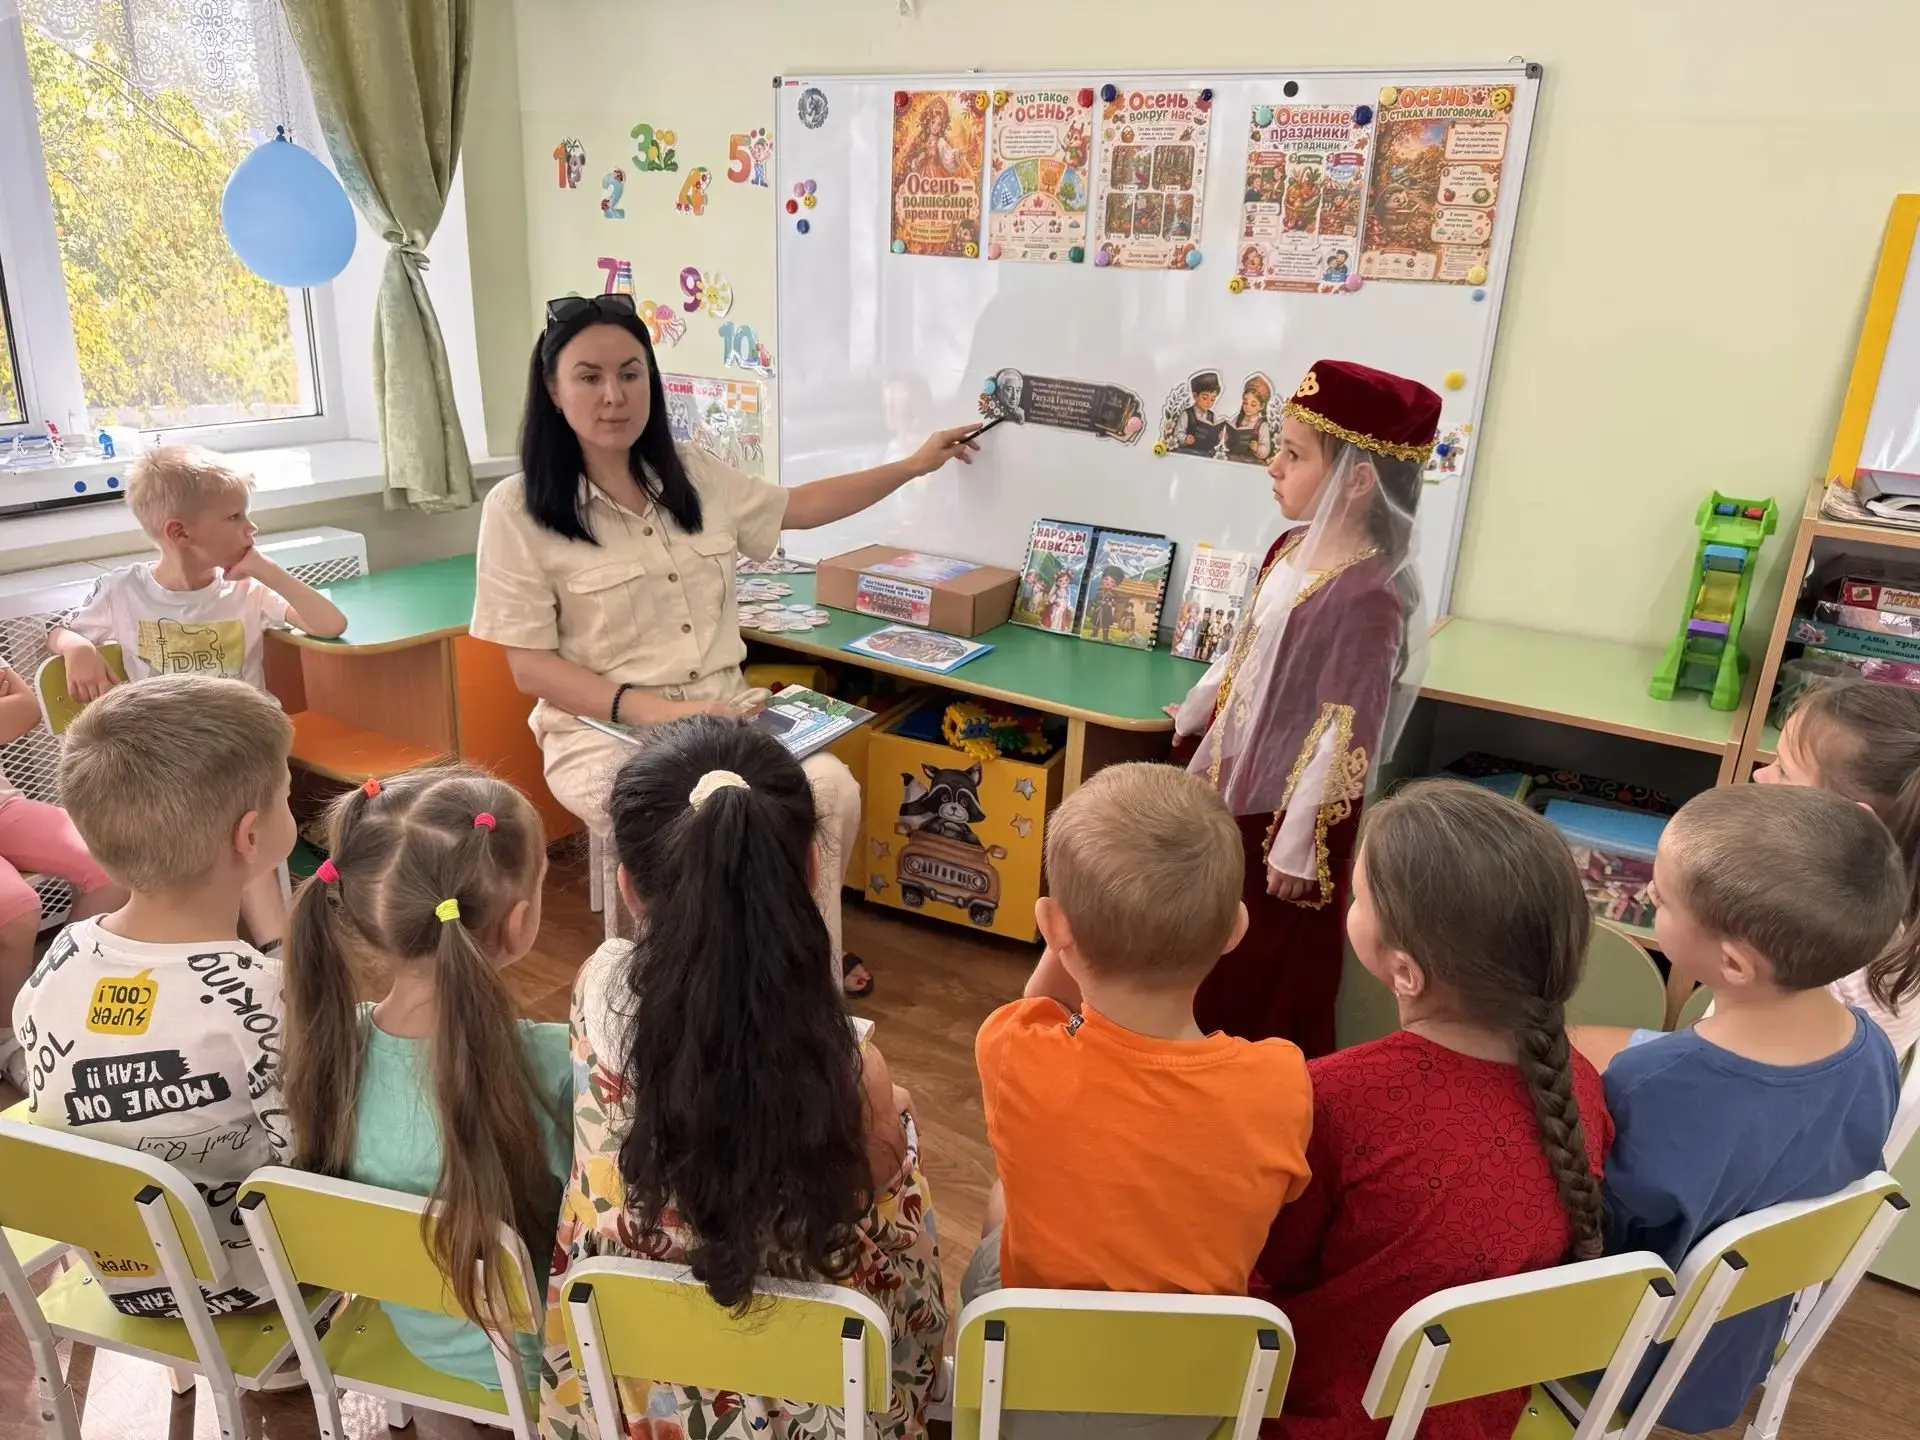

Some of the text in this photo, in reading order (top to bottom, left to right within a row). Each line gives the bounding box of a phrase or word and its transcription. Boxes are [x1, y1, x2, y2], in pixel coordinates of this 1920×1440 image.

[1129, 92, 1188, 111] Осень
[1400, 88, 1470, 108] ОСЕНЬ
[1015, 103, 1075, 122] ОСЕНЬ?
[1129, 109, 1192, 122] вокруг нас
[1276, 107, 1350, 126] Осенние
[1390, 109, 1424, 120] СТИХАХ
[1427, 108, 1433, 118] И
[1436, 107, 1495, 118] ПОГОВОРКАХ
[1270, 127, 1349, 141] праздники
[630, 123, 654, 171] 3
[1292, 141, 1340, 151] традиции
[553, 142, 567, 188] 1
[727, 134, 751, 183] 5
[678, 167, 708, 216] 4
[907, 174, 959, 194] Осень
[602, 171, 625, 219] 2
[902, 194, 973, 208] волшебное
[905, 209, 970, 222] время года!
[597, 257, 617, 294] 7
[680, 267, 702, 312] 9
[718, 321, 757, 367] 10
[1036, 527, 1087, 543] НАРОДЫ
[1032, 539, 1084, 555] КАВКАЗА
[1837, 628, 1860, 640] Раз,
[1864, 635, 1889, 646] два,
[98, 985, 152, 1004] COOL!
[105, 1060, 164, 1086] YEAH
[72, 1079, 215, 1121] MOVE ON
[137, 1294, 175, 1311] EAH
